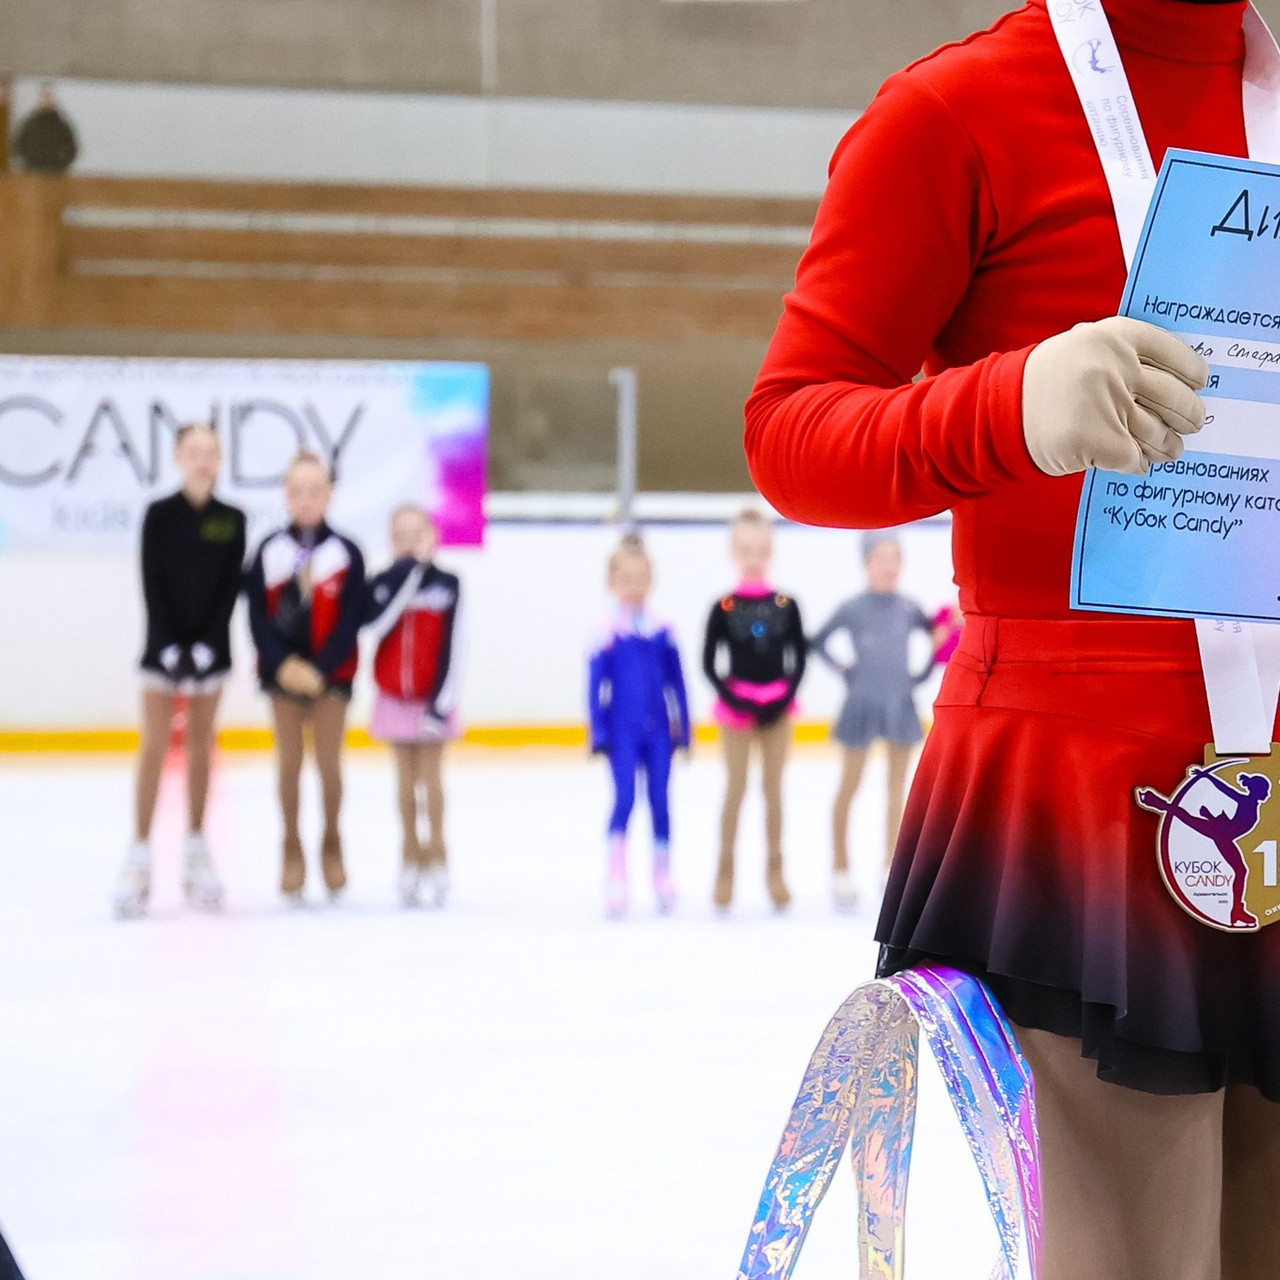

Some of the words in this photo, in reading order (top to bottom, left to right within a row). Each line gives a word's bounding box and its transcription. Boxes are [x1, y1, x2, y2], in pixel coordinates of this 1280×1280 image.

[1149, 460, 1270, 483] ревнованиях
[1106, 481, 1129, 497] по
[1133, 481, 1241, 512] фигурному
[1174, 860, 1222, 874] КУБОК
[1252, 840, 1277, 887] 1
[1185, 875, 1233, 887] CANDY
